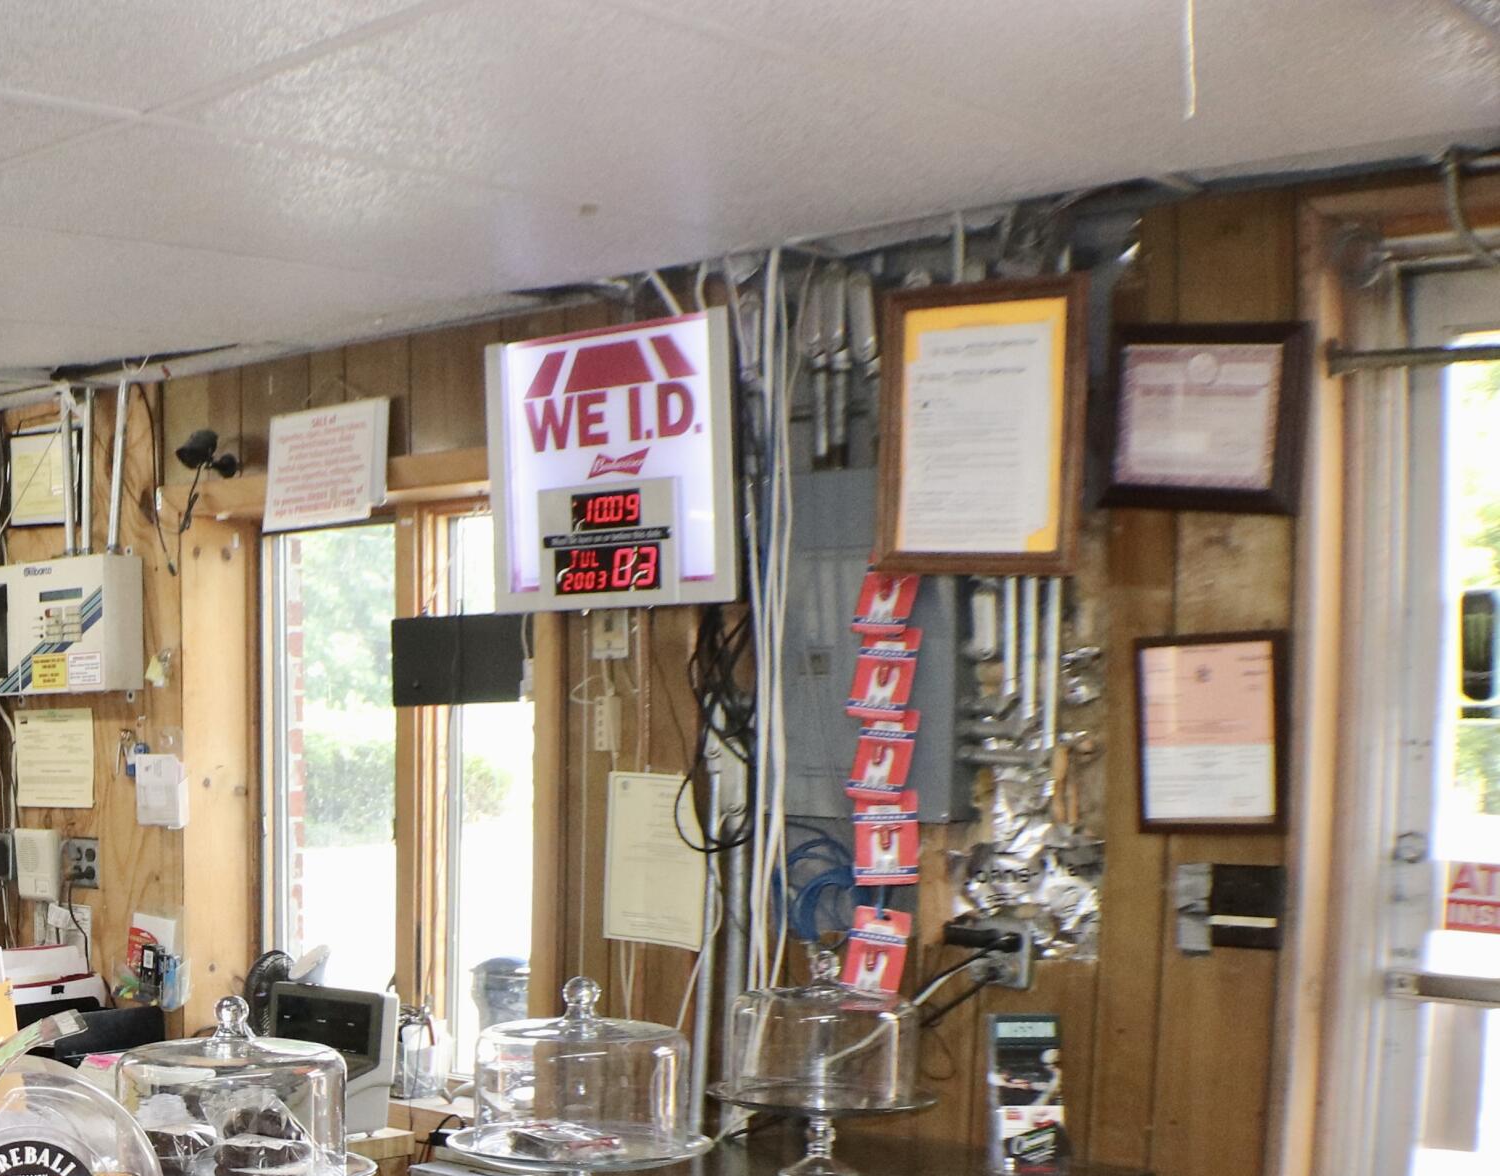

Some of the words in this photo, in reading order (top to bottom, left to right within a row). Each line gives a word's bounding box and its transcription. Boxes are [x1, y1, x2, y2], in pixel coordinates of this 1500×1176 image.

[524, 391, 608, 453] WE
[628, 381, 703, 442] I.D.
[570, 550, 599, 568] JUL
[611, 546, 658, 587] 03
[563, 570, 607, 591] 2003
